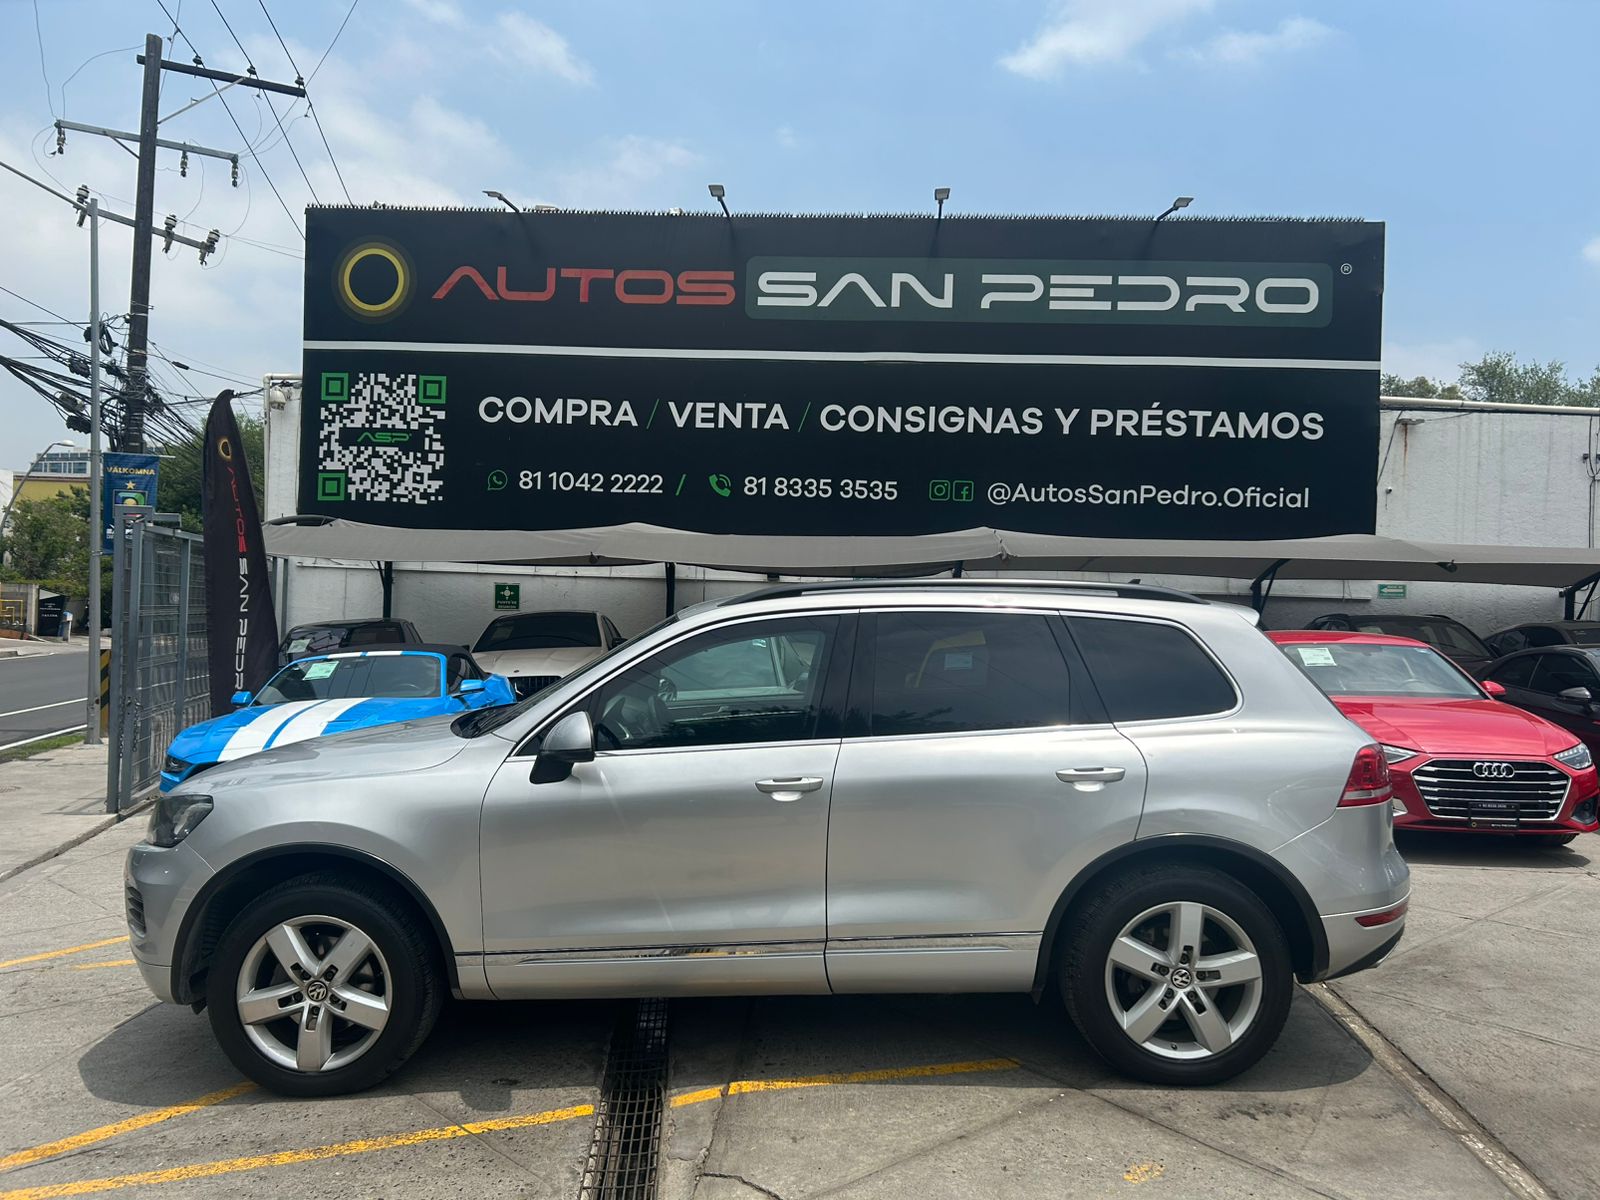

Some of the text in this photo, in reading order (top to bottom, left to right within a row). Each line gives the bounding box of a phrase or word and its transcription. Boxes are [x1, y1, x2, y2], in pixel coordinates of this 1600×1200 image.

[432, 265, 736, 306] AUTOS
[757, 271, 954, 309] SAN
[980, 273, 1320, 315] PEDRO
[478, 396, 639, 428] COMPRA
[668, 401, 790, 431] VENTA
[819, 404, 1043, 436] CONSIGNAS
[1054, 407, 1080, 435] Y
[1090, 402, 1325, 441] PRÉSTAMOS
[518, 469, 542, 491] 81
[548, 471, 605, 493] 1042
[610, 473, 664, 494] 2222
[743, 475, 767, 497] 81
[773, 477, 833, 498] 8335
[839, 478, 899, 501] 3535
[987, 481, 1310, 509] @AutosSanPedro.Oficial
[238, 556, 250, 613] SAN
[234, 618, 249, 690] PEDR
